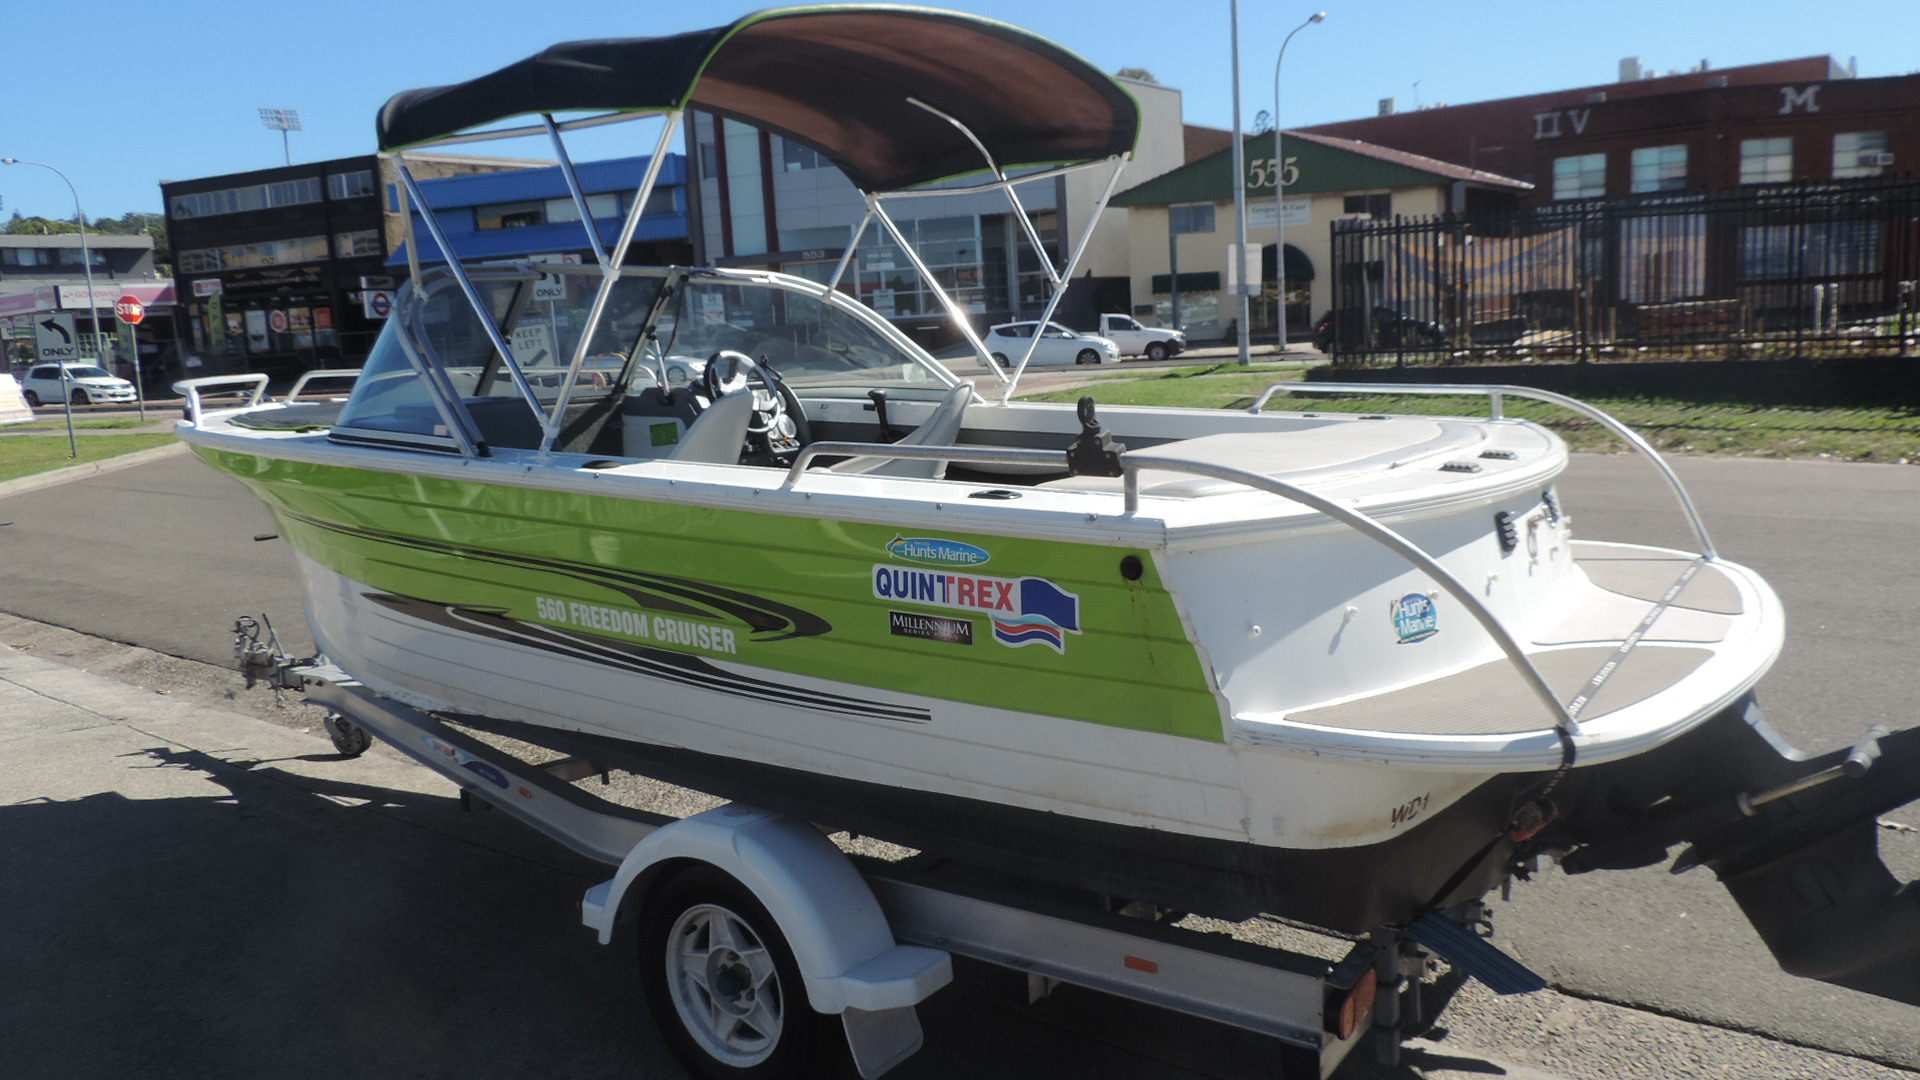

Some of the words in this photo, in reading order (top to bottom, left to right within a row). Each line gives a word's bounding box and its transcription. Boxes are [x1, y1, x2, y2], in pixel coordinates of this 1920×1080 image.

[1247, 156, 1299, 189] 555
[75, 290, 119, 298] GODWILL
[536, 287, 563, 298] ONLY
[117, 303, 142, 315] STOP
[516, 327, 541, 338] KEEP
[518, 338, 542, 350] LEFT
[42, 346, 75, 357] ONLY
[904, 543, 937, 559] Hunts
[938, 547, 978, 563] Marine
[876, 567, 1014, 612] QUINTREX
[536, 596, 567, 624] 560
[569, 602, 650, 638] FREEDOM
[653, 616, 737, 655] CRUISER
[892, 613, 970, 637] MILLENNIUM
